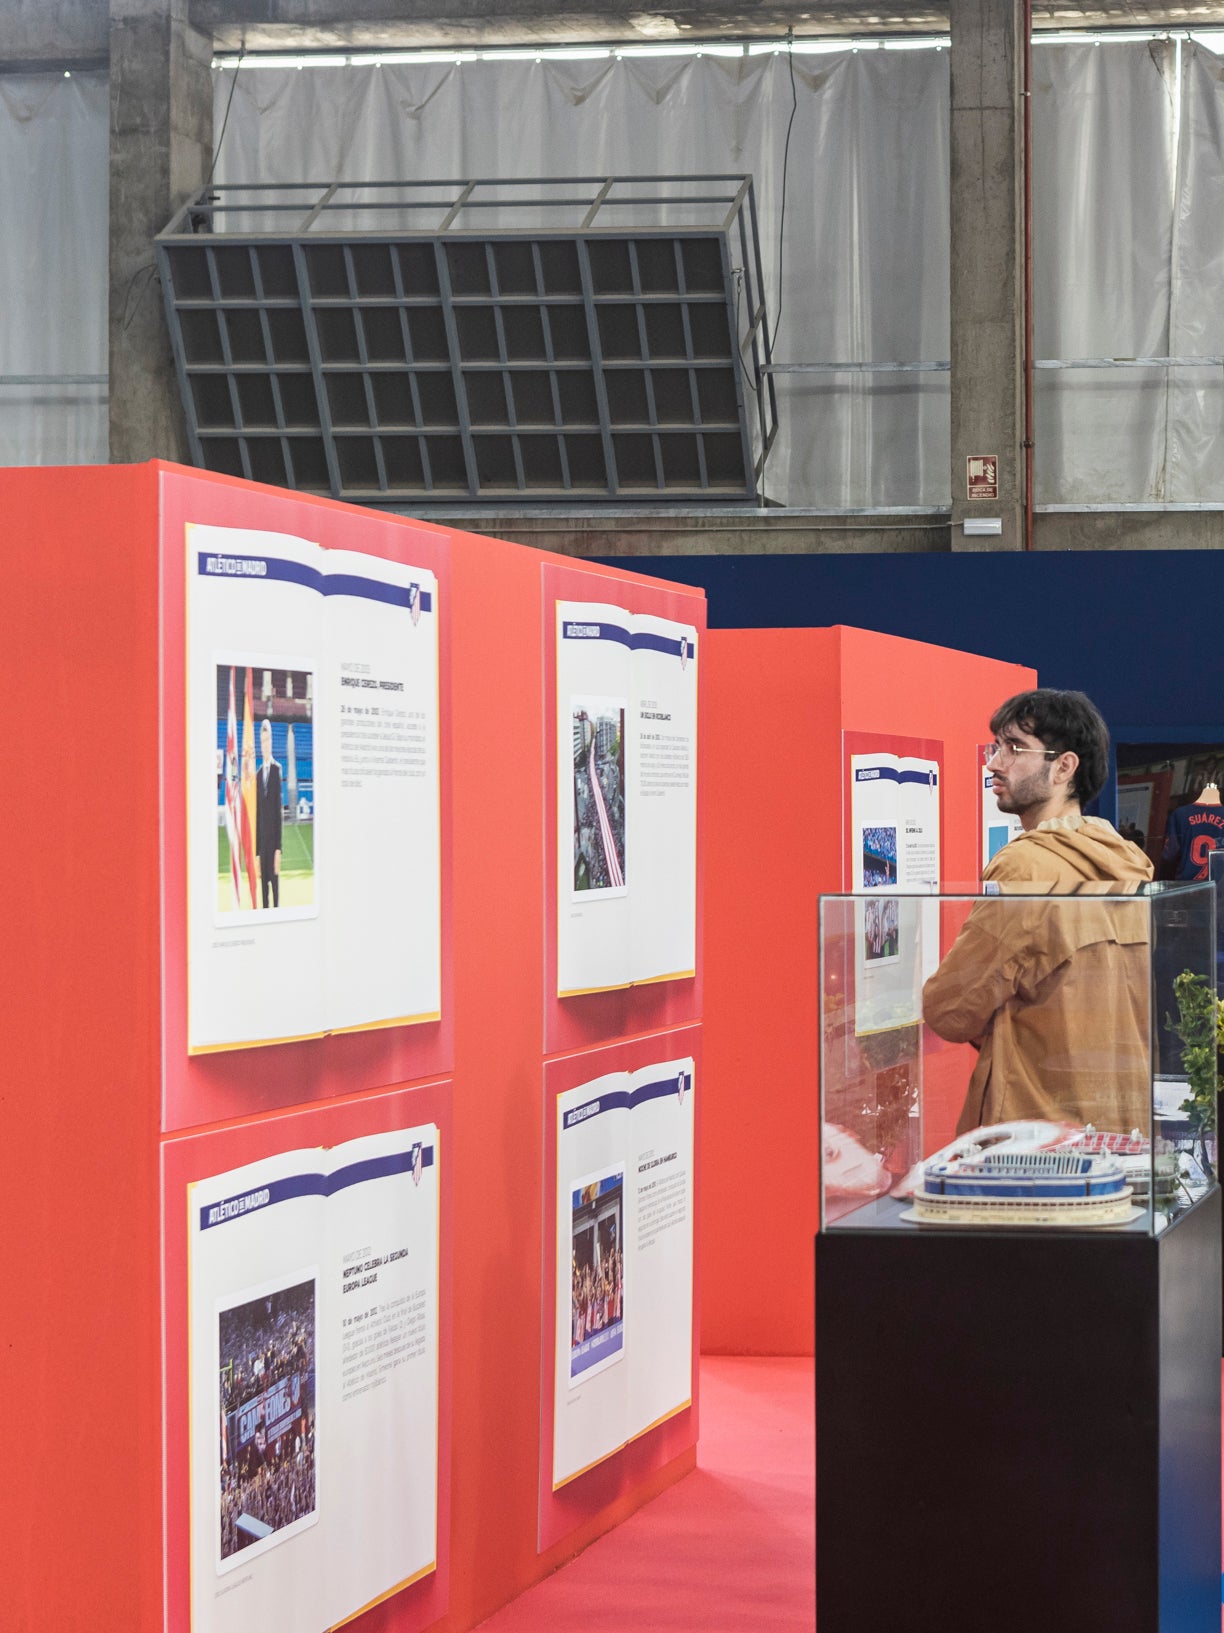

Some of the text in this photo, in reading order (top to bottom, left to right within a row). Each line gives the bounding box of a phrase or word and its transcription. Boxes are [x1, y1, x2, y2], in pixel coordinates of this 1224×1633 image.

[1190, 835, 1216, 880] 9
[208, 1200, 239, 1225] ATLÉTICO
[245, 1188, 270, 1211] MADRID
[240, 1388, 291, 1443] CAMEONES
